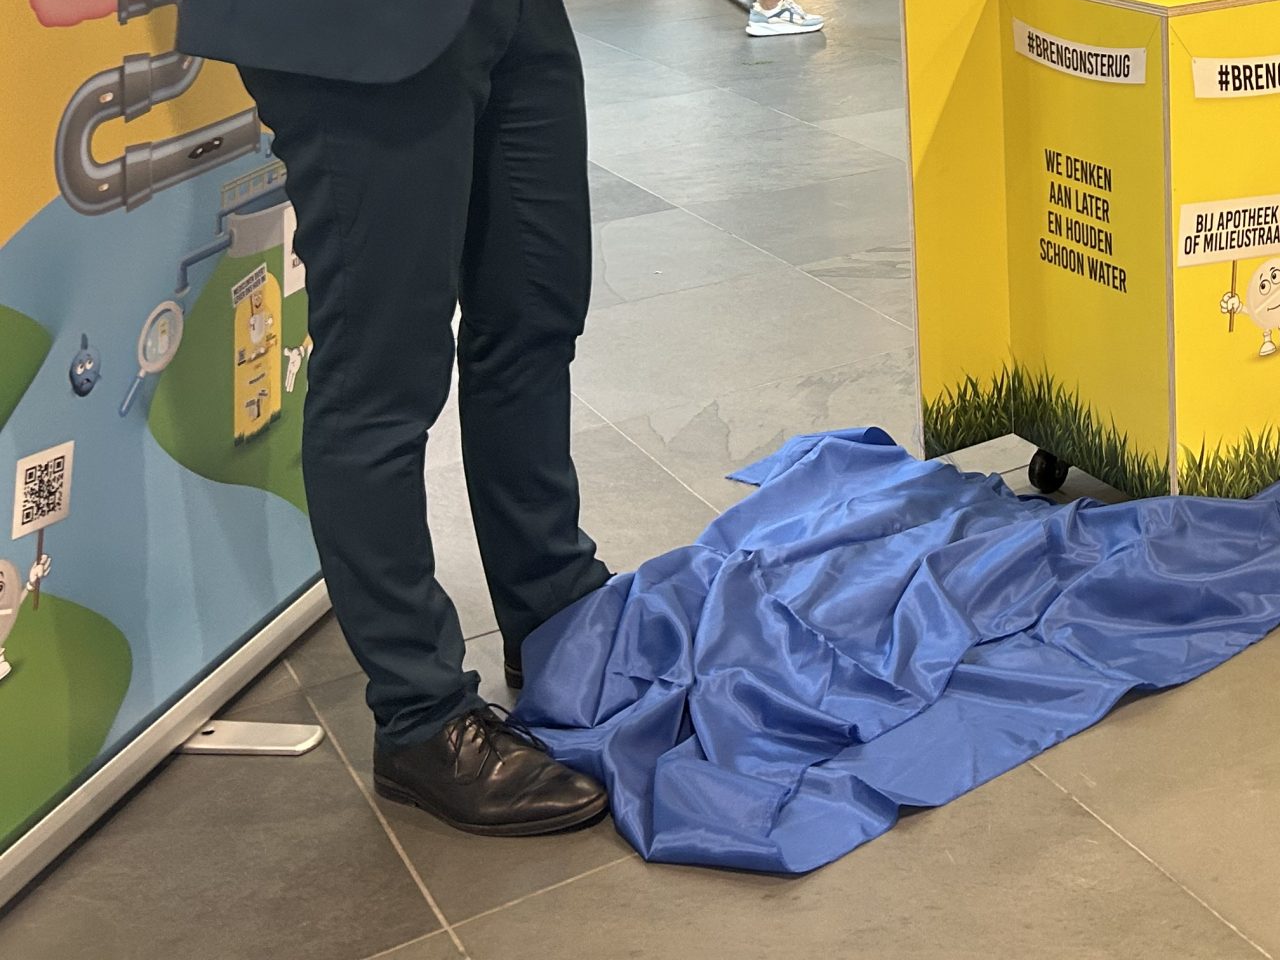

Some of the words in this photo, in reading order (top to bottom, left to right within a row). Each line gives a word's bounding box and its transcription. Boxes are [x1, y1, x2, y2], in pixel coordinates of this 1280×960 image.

[1027, 31, 1131, 78] #BRENGONSTERUG
[1044, 148, 1062, 176] WE
[1065, 155, 1112, 193] DENKEN
[1049, 181, 1072, 210] AAN
[1075, 188, 1110, 224] LATER
[1195, 212, 1214, 234] BIJ
[1217, 205, 1279, 231] APOTHEEK
[1047, 211, 1064, 237] EN
[1066, 215, 1112, 256] HOUDEN
[1184, 236, 1200, 256] OF
[1039, 238, 1084, 279] SCHOON
[1087, 255, 1127, 294] WATER
